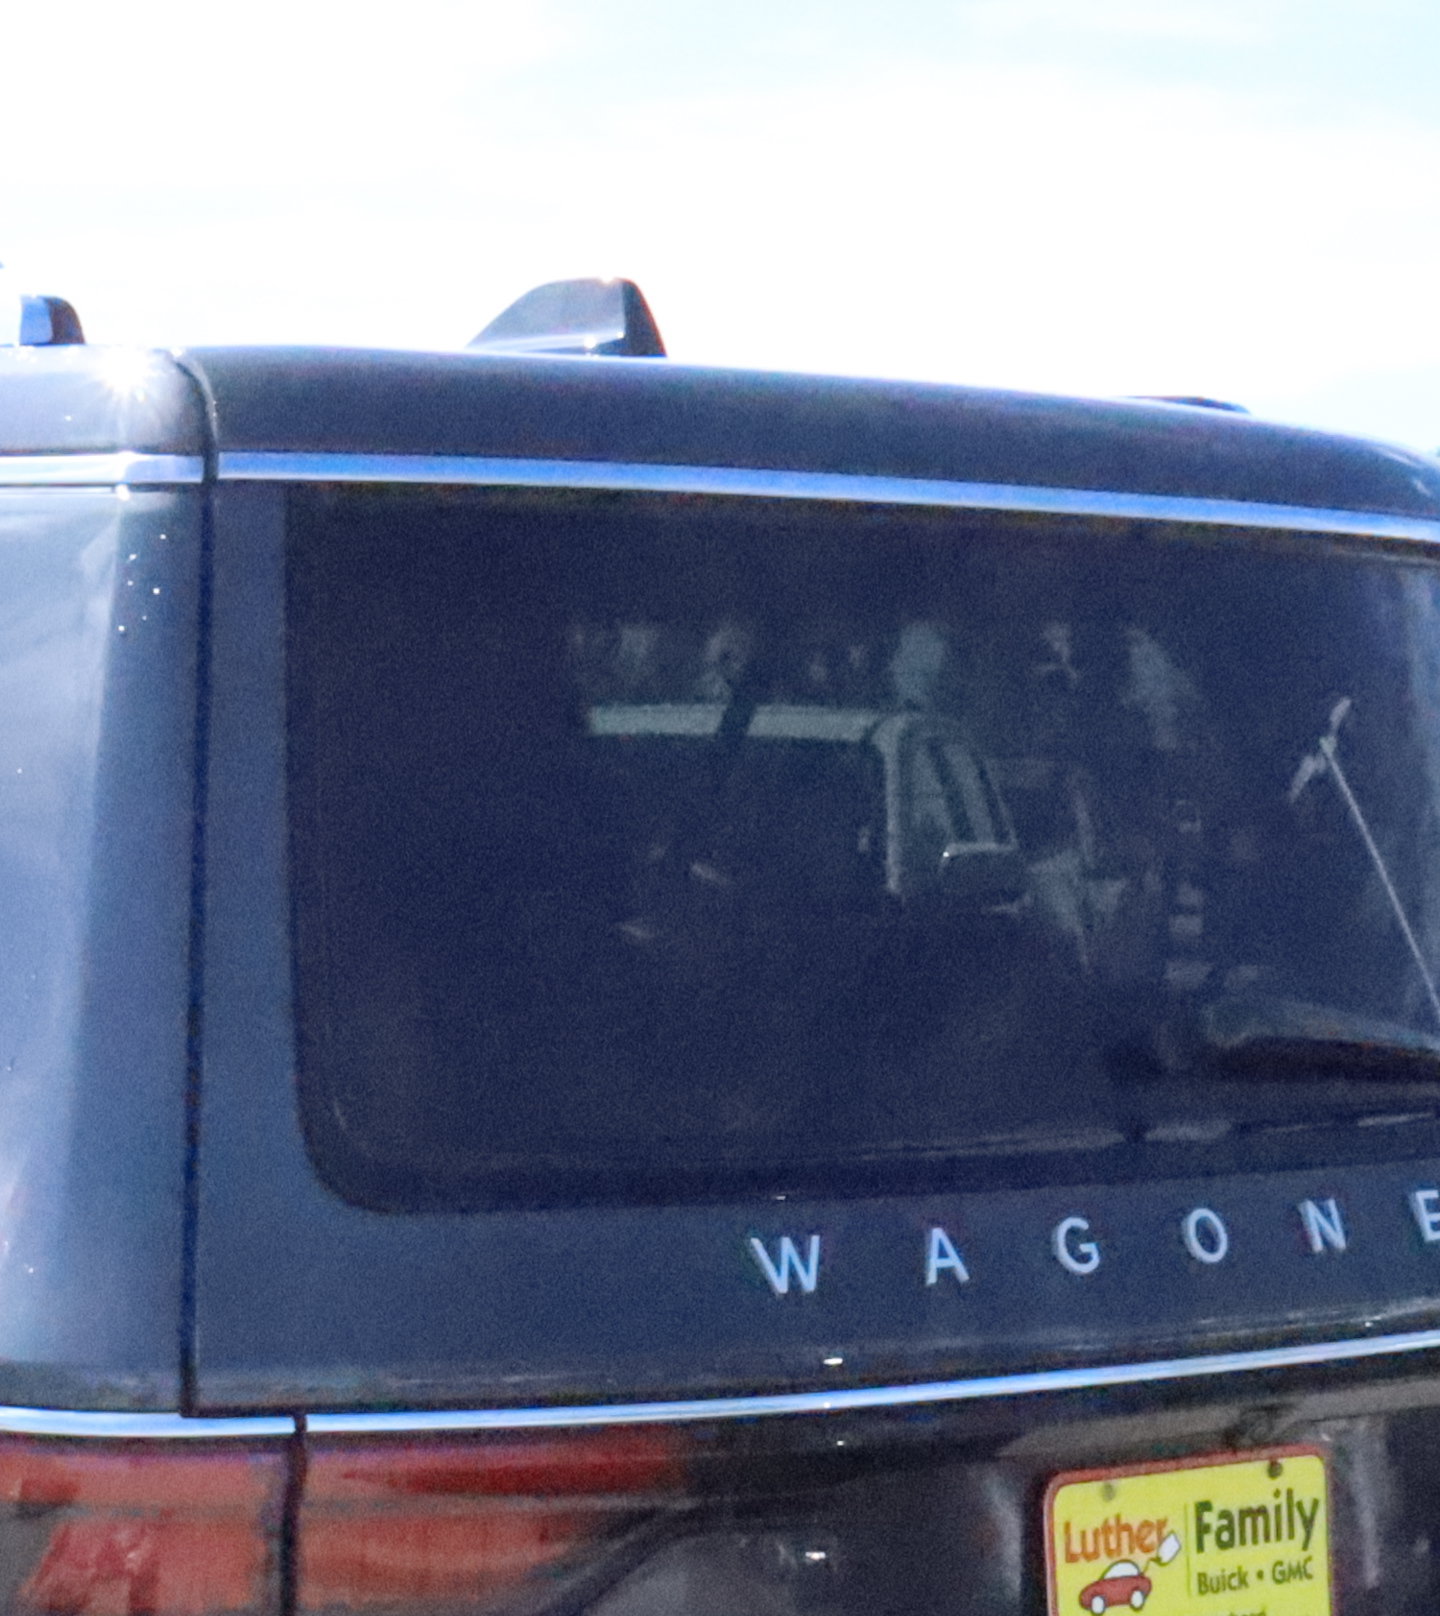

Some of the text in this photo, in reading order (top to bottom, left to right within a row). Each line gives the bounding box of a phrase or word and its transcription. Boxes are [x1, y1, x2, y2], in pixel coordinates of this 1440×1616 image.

[1063, 1513, 1169, 1564] Luther
[1194, 1487, 1320, 1554] Family
[1195, 1555, 1315, 1597] Buick GMC
